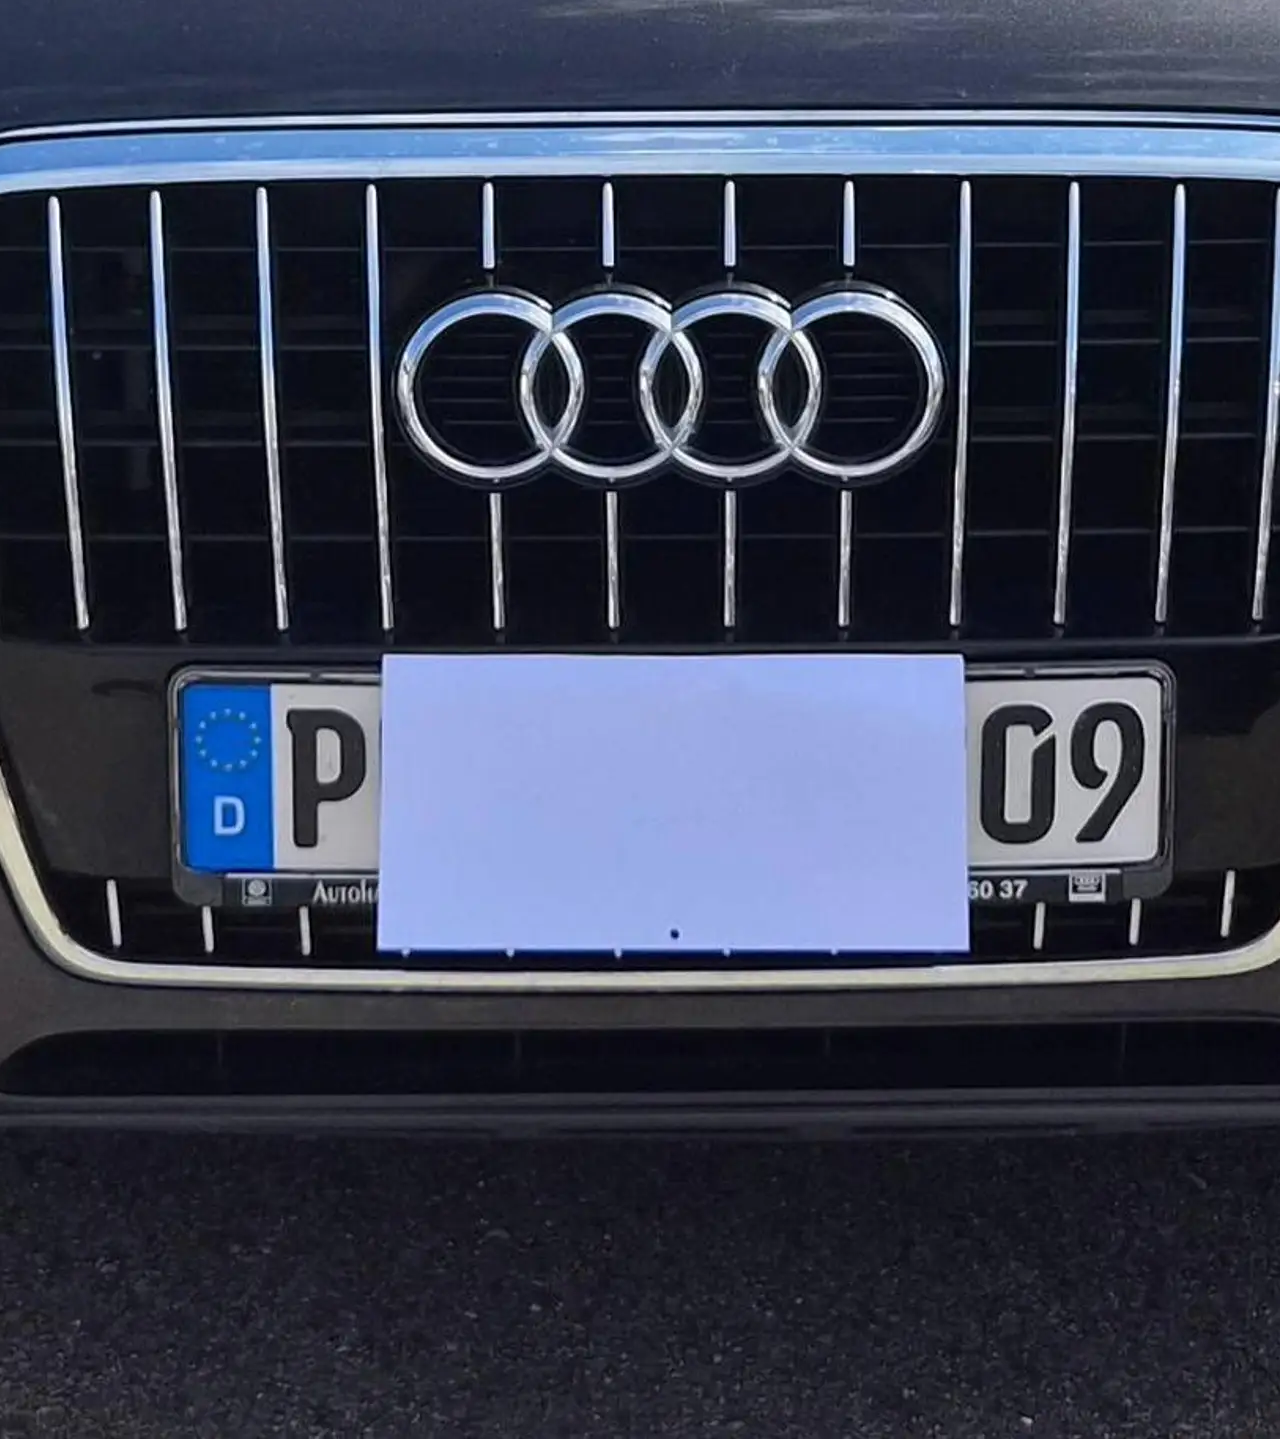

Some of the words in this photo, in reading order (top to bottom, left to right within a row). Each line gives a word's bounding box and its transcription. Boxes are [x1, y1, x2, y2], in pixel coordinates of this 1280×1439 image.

[286, 708, 366, 848] P
[980, 701, 1146, 845] 09
[213, 795, 246, 837] D
[999, 879, 1028, 899] 37
